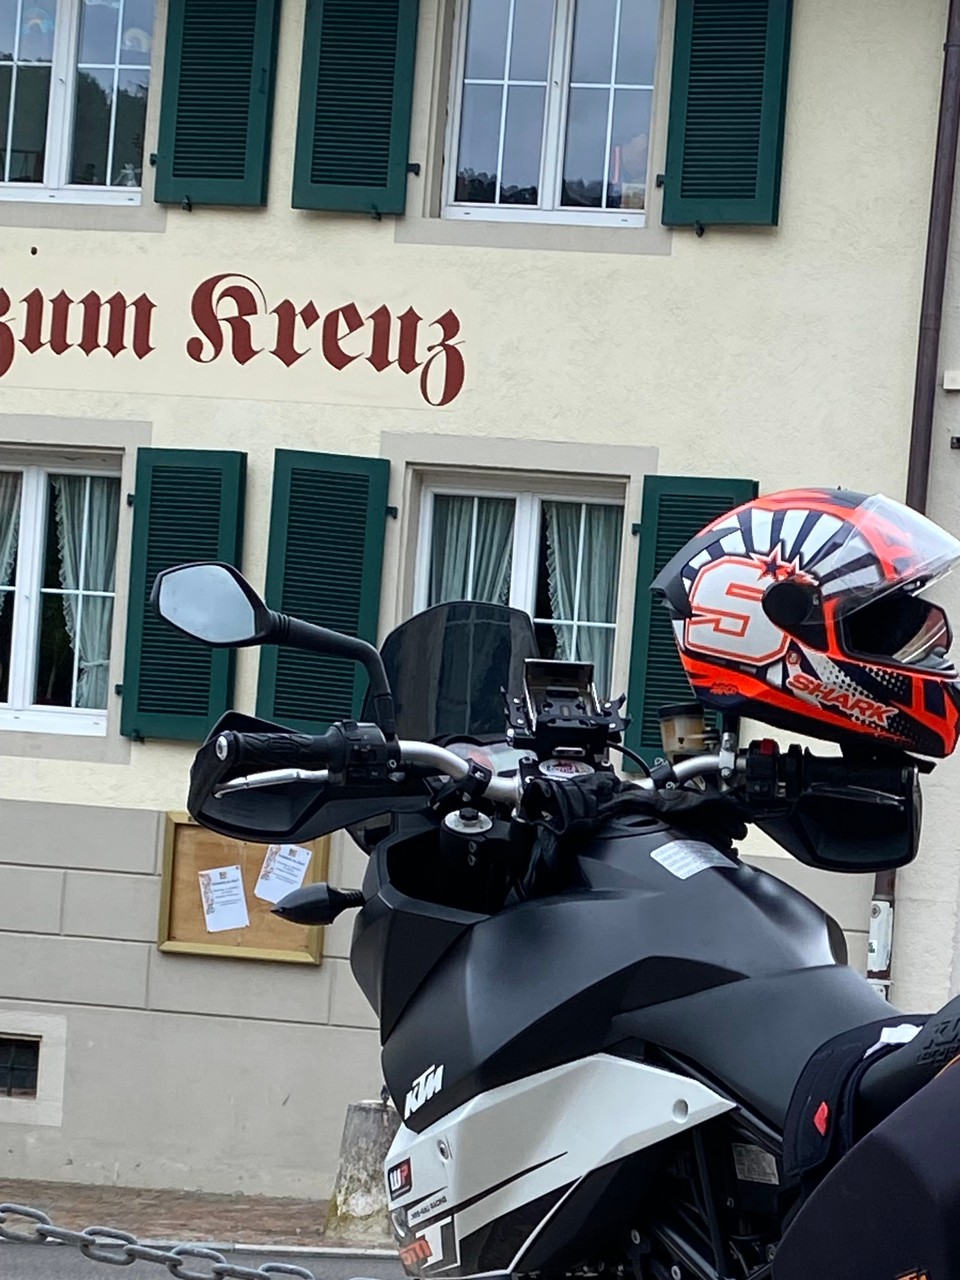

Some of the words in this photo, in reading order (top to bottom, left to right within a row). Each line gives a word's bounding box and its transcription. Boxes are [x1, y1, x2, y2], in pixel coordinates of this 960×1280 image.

[186, 272, 466, 406] Kreuz
[788, 673, 897, 725] SHARK
[403, 1063, 445, 1121] KTM
